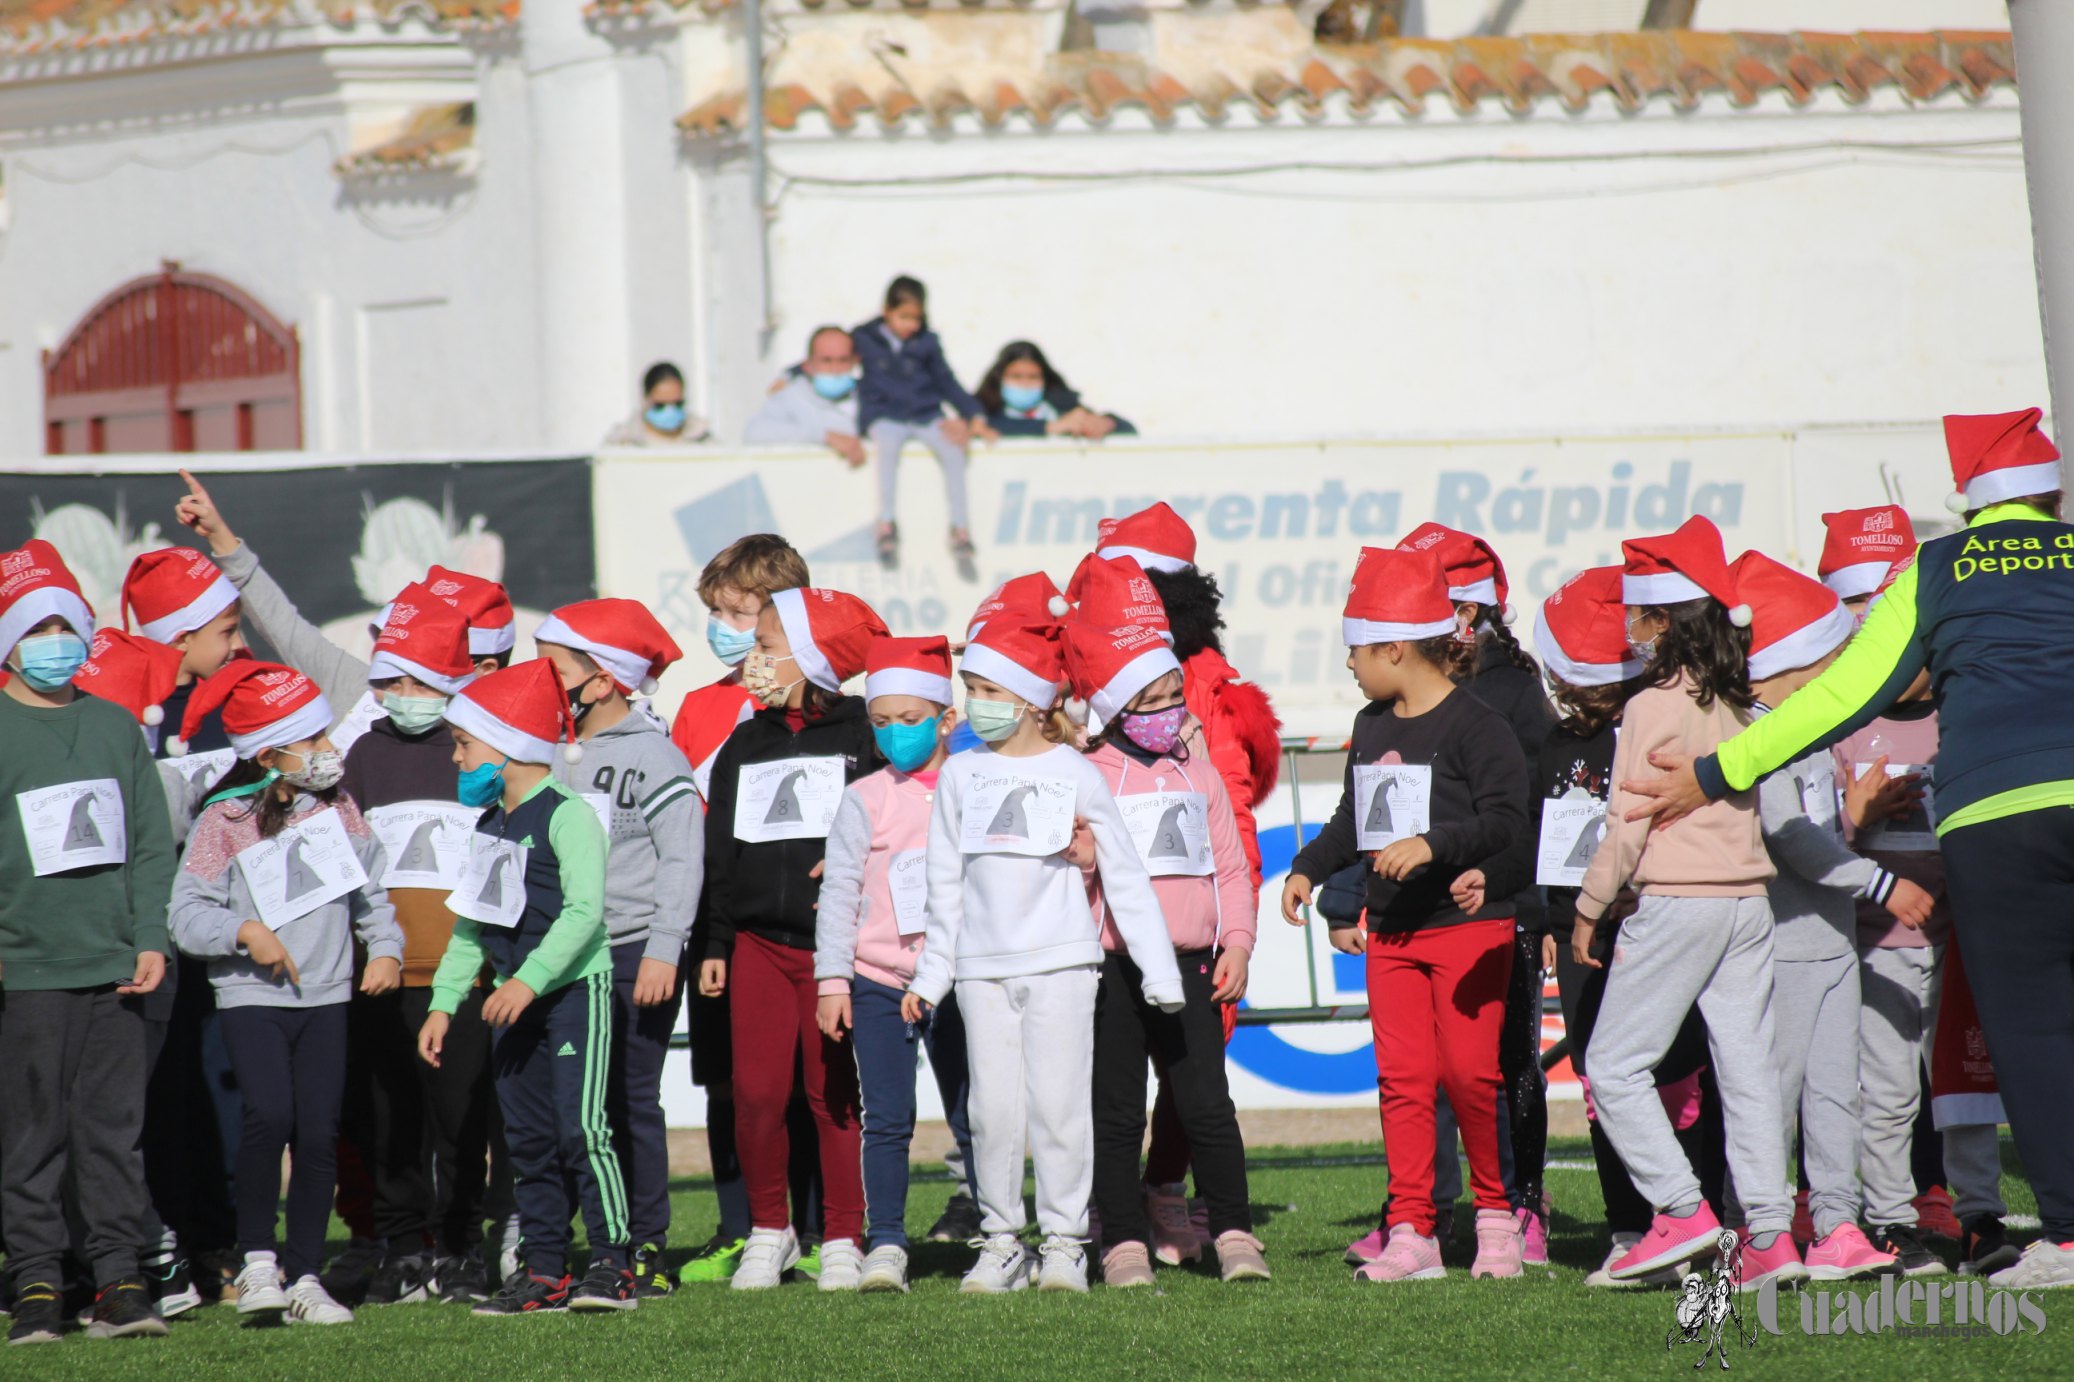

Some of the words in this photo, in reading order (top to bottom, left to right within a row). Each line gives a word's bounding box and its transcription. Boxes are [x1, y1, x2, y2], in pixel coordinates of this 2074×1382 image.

[1434, 460, 1744, 546] Rápida
[1851, 533, 1903, 546] TOMELLOSO
[1962, 535, 2043, 555] Área
[749, 767, 780, 785] Carrera
[782, 763, 805, 774] Papá
[807, 763, 835, 779] Noel
[1398, 771, 1422, 787] Noel
[973, 777, 1009, 792] Carrera
[1011, 775, 1037, 789] Papá
[1039, 782, 1066, 799] Noel
[30, 790, 70, 813] Carrera
[777, 799, 789, 816] 8
[1121, 799, 1160, 817] Carrera
[1161, 796, 1185, 808] Papá
[379, 812, 415, 829] Carrera
[416, 810, 443, 822] Papá
[444, 812, 471, 831] Noel
[1002, 811, 1014, 828] 3
[1374, 807, 1382, 825] 2
[1552, 808, 1586, 821] Carrera
[71, 823, 95, 842] 14
[1164, 832, 1175, 850] 3
[248, 843, 281, 870] Carrera
[303, 825, 332, 837] Noel
[411, 848, 423, 865] 3
[1579, 844, 1590, 861] 4
[293, 870, 303, 886] 7
[488, 880, 497, 897] 7
